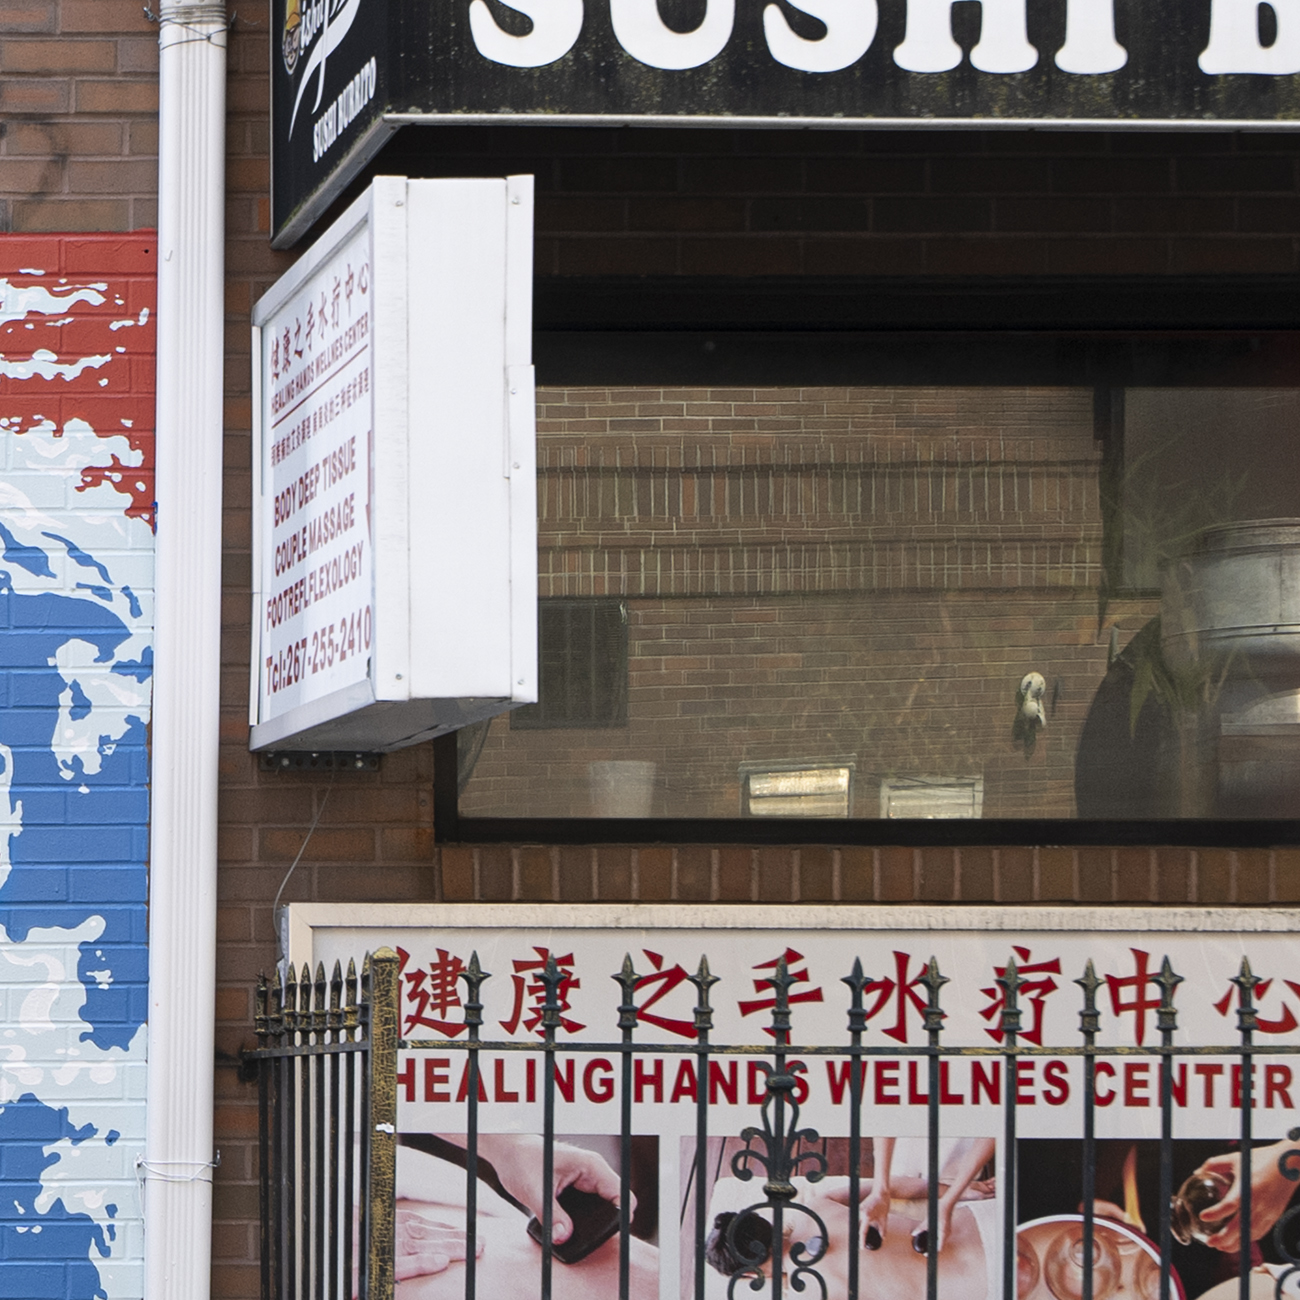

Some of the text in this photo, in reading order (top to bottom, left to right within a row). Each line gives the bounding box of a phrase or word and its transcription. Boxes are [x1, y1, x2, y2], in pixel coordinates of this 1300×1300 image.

[271, 379, 296, 416] HEALING
[296, 361, 314, 400] HANDS
[344, 311, 369, 357] CENTER
[275, 436, 356, 528] BODY DEEP TISSUE
[275, 492, 355, 577] COUPLE MASSAGE
[397, 946, 1300, 1047] 健康之手水疗中心
[397, 1058, 1295, 1109] HEALING HANDS WELLNES CENTER
